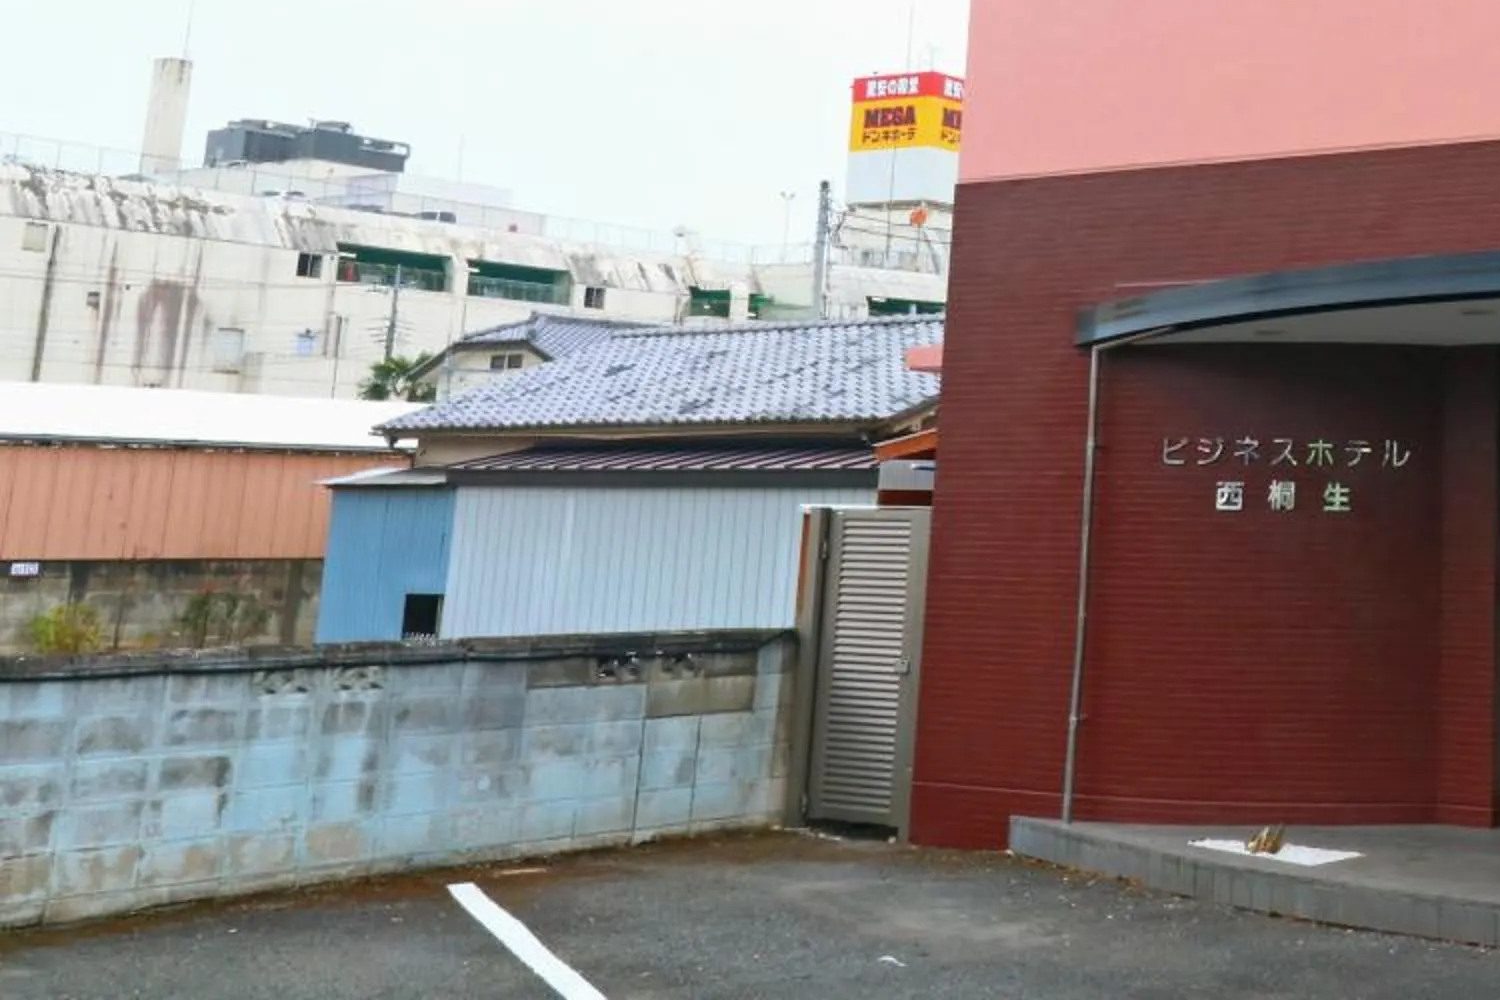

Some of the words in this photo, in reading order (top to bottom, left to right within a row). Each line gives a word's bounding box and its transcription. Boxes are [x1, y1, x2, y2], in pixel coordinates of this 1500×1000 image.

[864, 105, 916, 129] MEGA
[1162, 435, 1412, 468] ビジネスホテル
[1214, 478, 1352, 512] 西桐生
